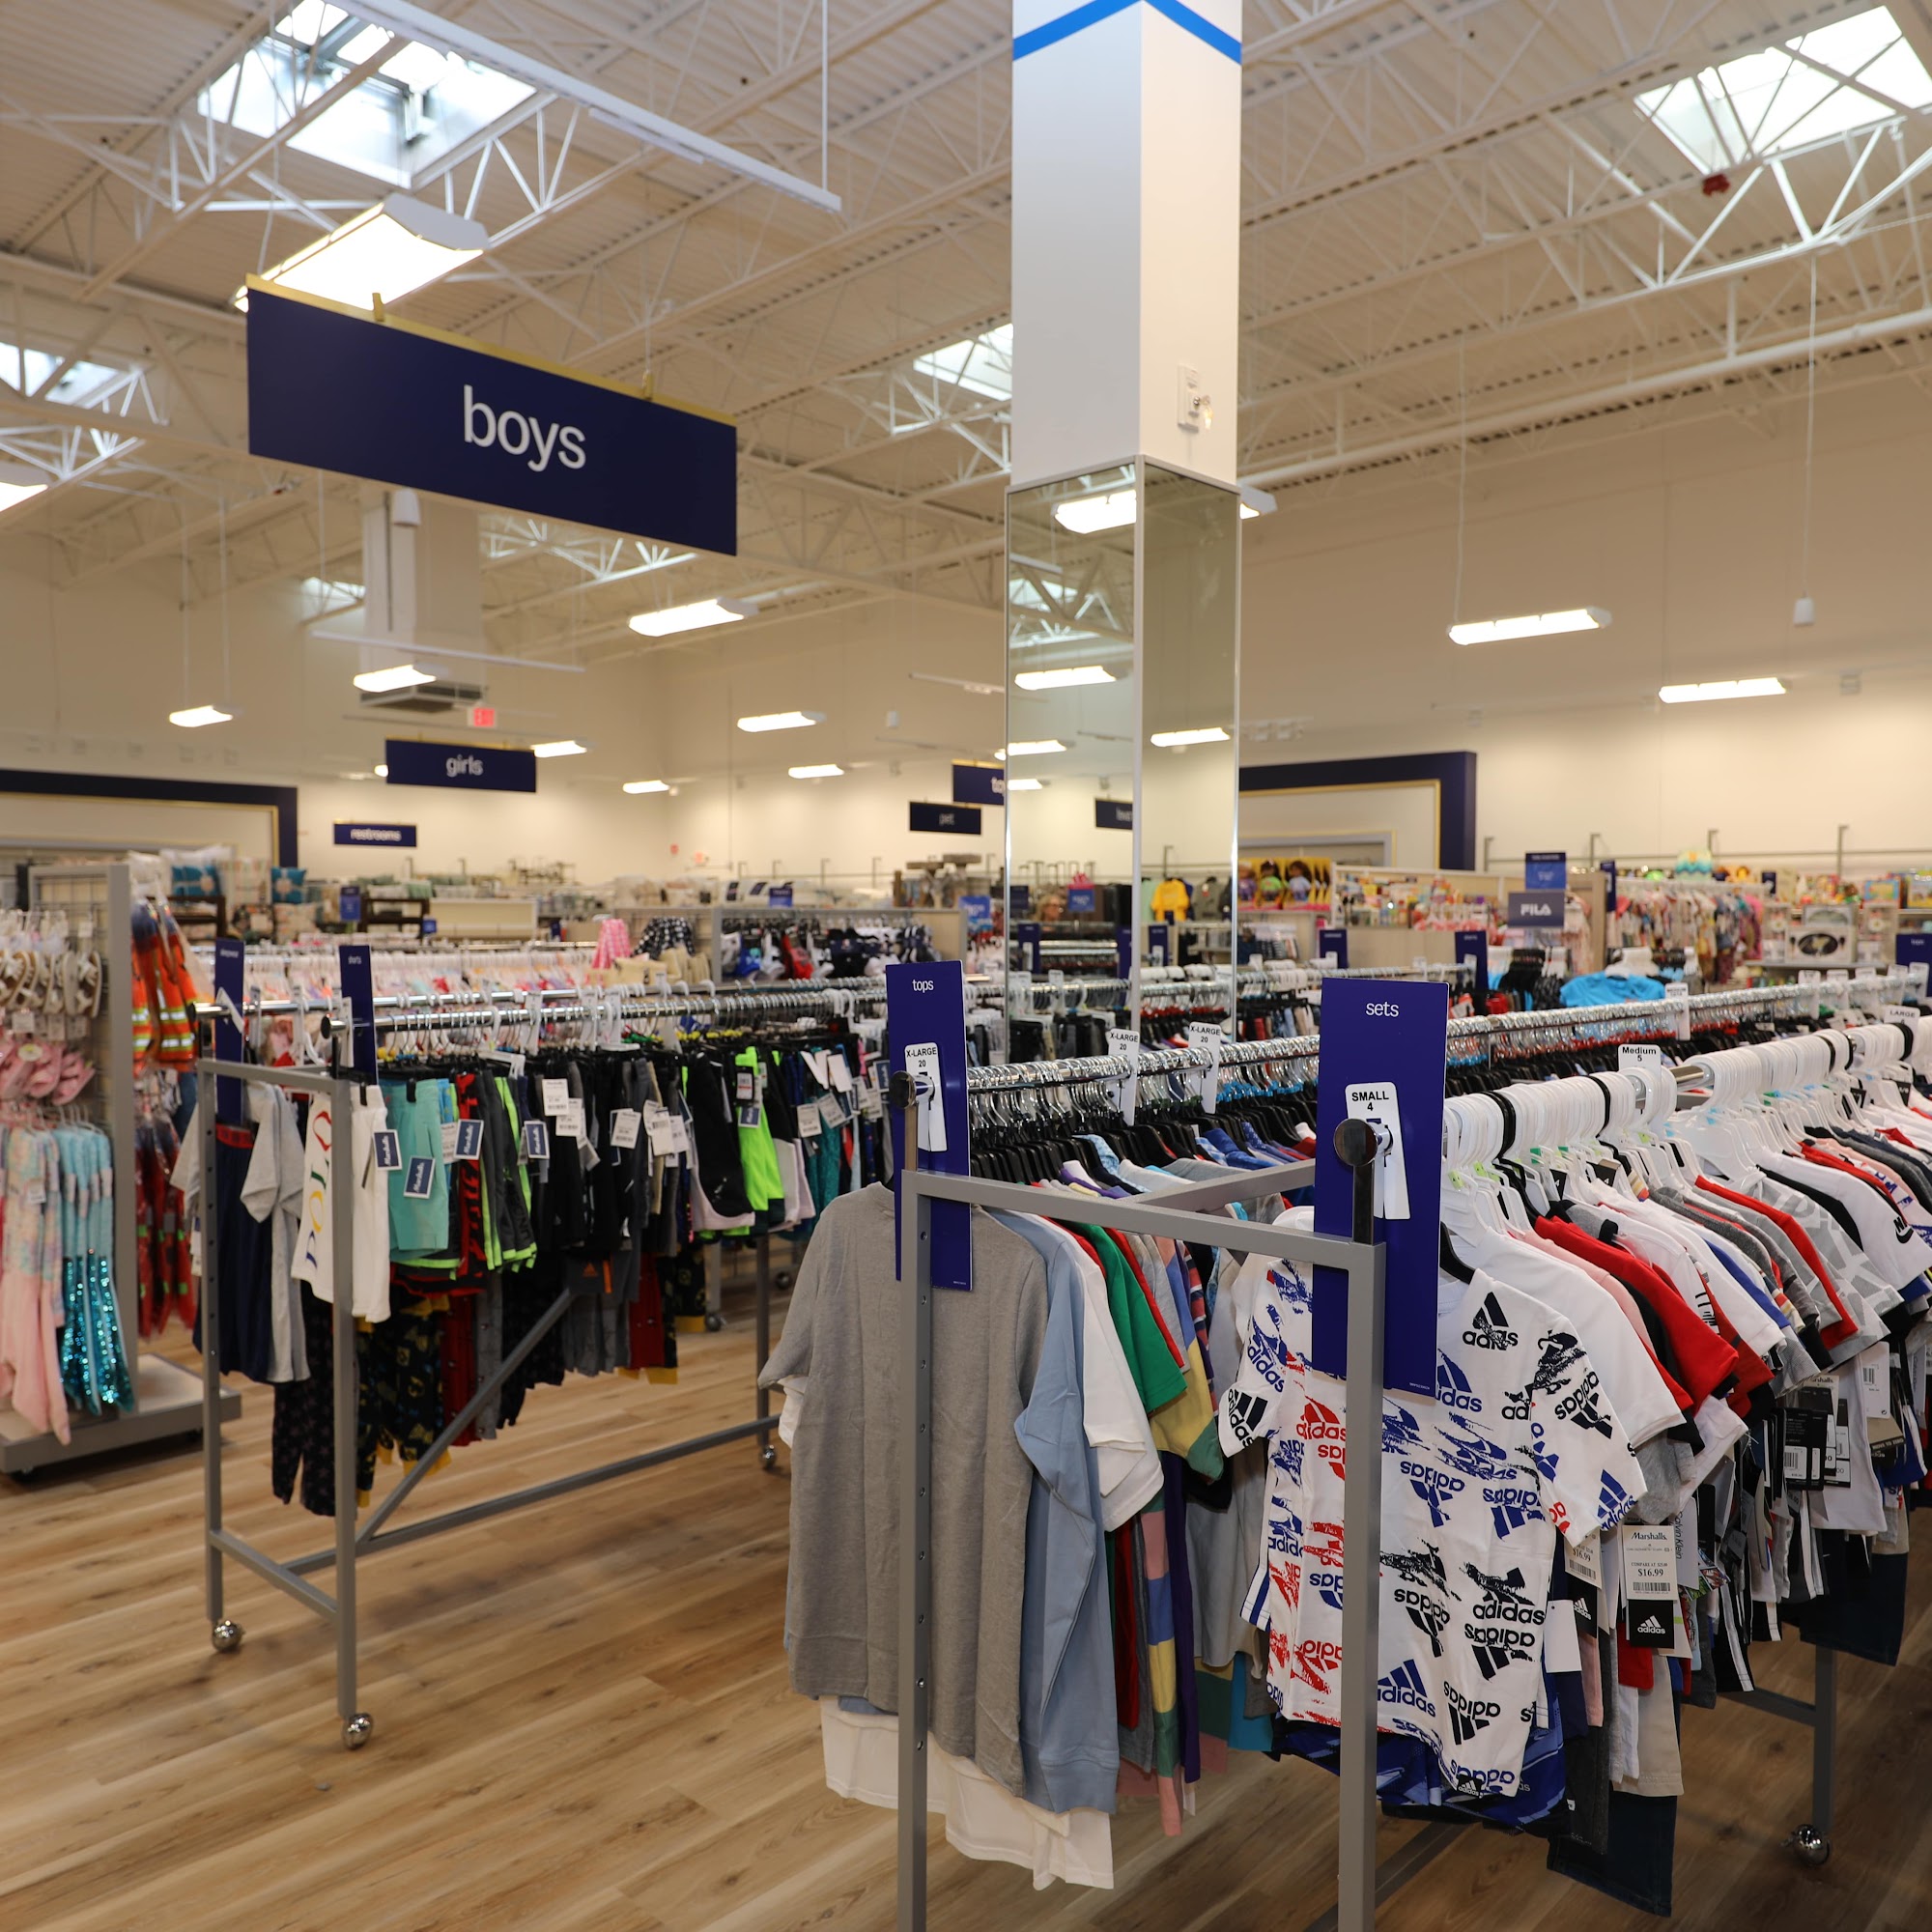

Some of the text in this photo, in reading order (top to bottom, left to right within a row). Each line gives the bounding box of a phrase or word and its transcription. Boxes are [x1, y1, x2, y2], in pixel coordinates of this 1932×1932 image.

[464, 384, 586, 471] boys
[446, 754, 484, 777] girls
[350, 829, 402, 841] restrooms
[1520, 903, 1551, 917] FILA
[912, 979, 934, 994] tops
[1366, 1002, 1399, 1017] sets
[1889, 1009, 1916, 1018] LARGE
[1110, 1032, 1139, 1043] X-LARGE
[1190, 1025, 1221, 1037] X-LARGE
[906, 1046, 937, 1058] X-LARGE
[1622, 1046, 1657, 1055] Medium
[1351, 1091, 1389, 1102] SMALL
[1367, 1102, 1374, 1111] 4
[464, 1124, 474, 1154] Marshalls
[383, 1134, 392, 1167] Marshalls
[413, 1161, 425, 1194] Marshalls
[305, 1111, 332, 1270] POLO
[1246, 1343, 1285, 1393] didas
[1436, 1388, 1483, 1413] idas
[1554, 1370, 1600, 1421] adidas
[1400, 1461, 1465, 1492] adidas
[1483, 1488, 1541, 1507] didas
[1675, 1511, 1684, 1538] Calvin
[1573, 1548, 1591, 1562] $16.99
[1309, 1573, 1344, 1592] das
[1637, 1569, 1664, 1577] $16.99
[1394, 1587, 1451, 1625] addas
[1472, 1600, 1547, 1626] adidas
[1463, 1623, 1536, 1647] adidas
[1637, 1626, 1666, 1634] adidas
[1443, 1681, 1501, 1720] adidas
[1458, 1785, 1479, 1797] adidas
